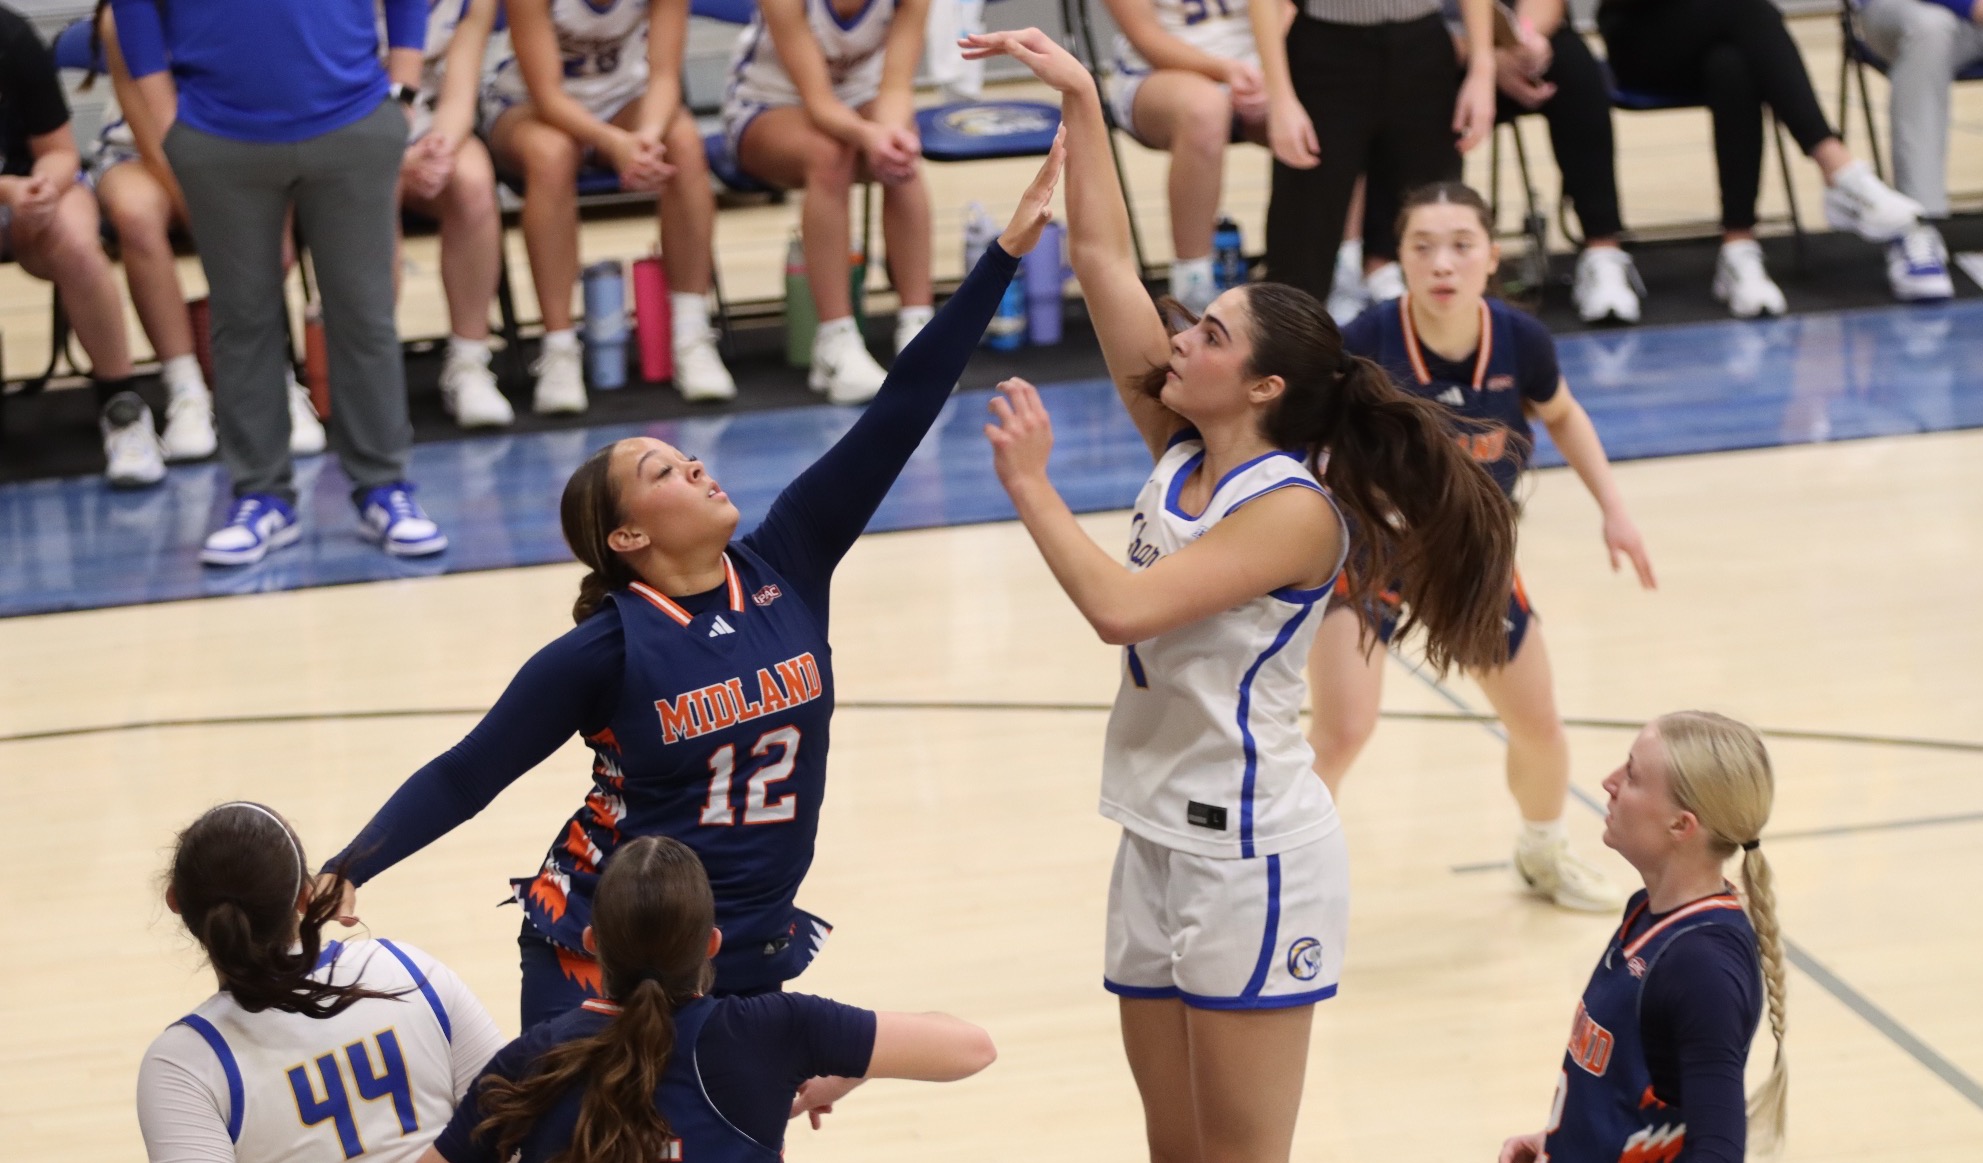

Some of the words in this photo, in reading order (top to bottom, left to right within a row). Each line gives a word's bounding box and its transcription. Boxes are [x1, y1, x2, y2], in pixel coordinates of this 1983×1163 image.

[654, 652, 823, 745] MIDLAND
[699, 724, 802, 826] 12
[285, 1026, 421, 1161] 44
